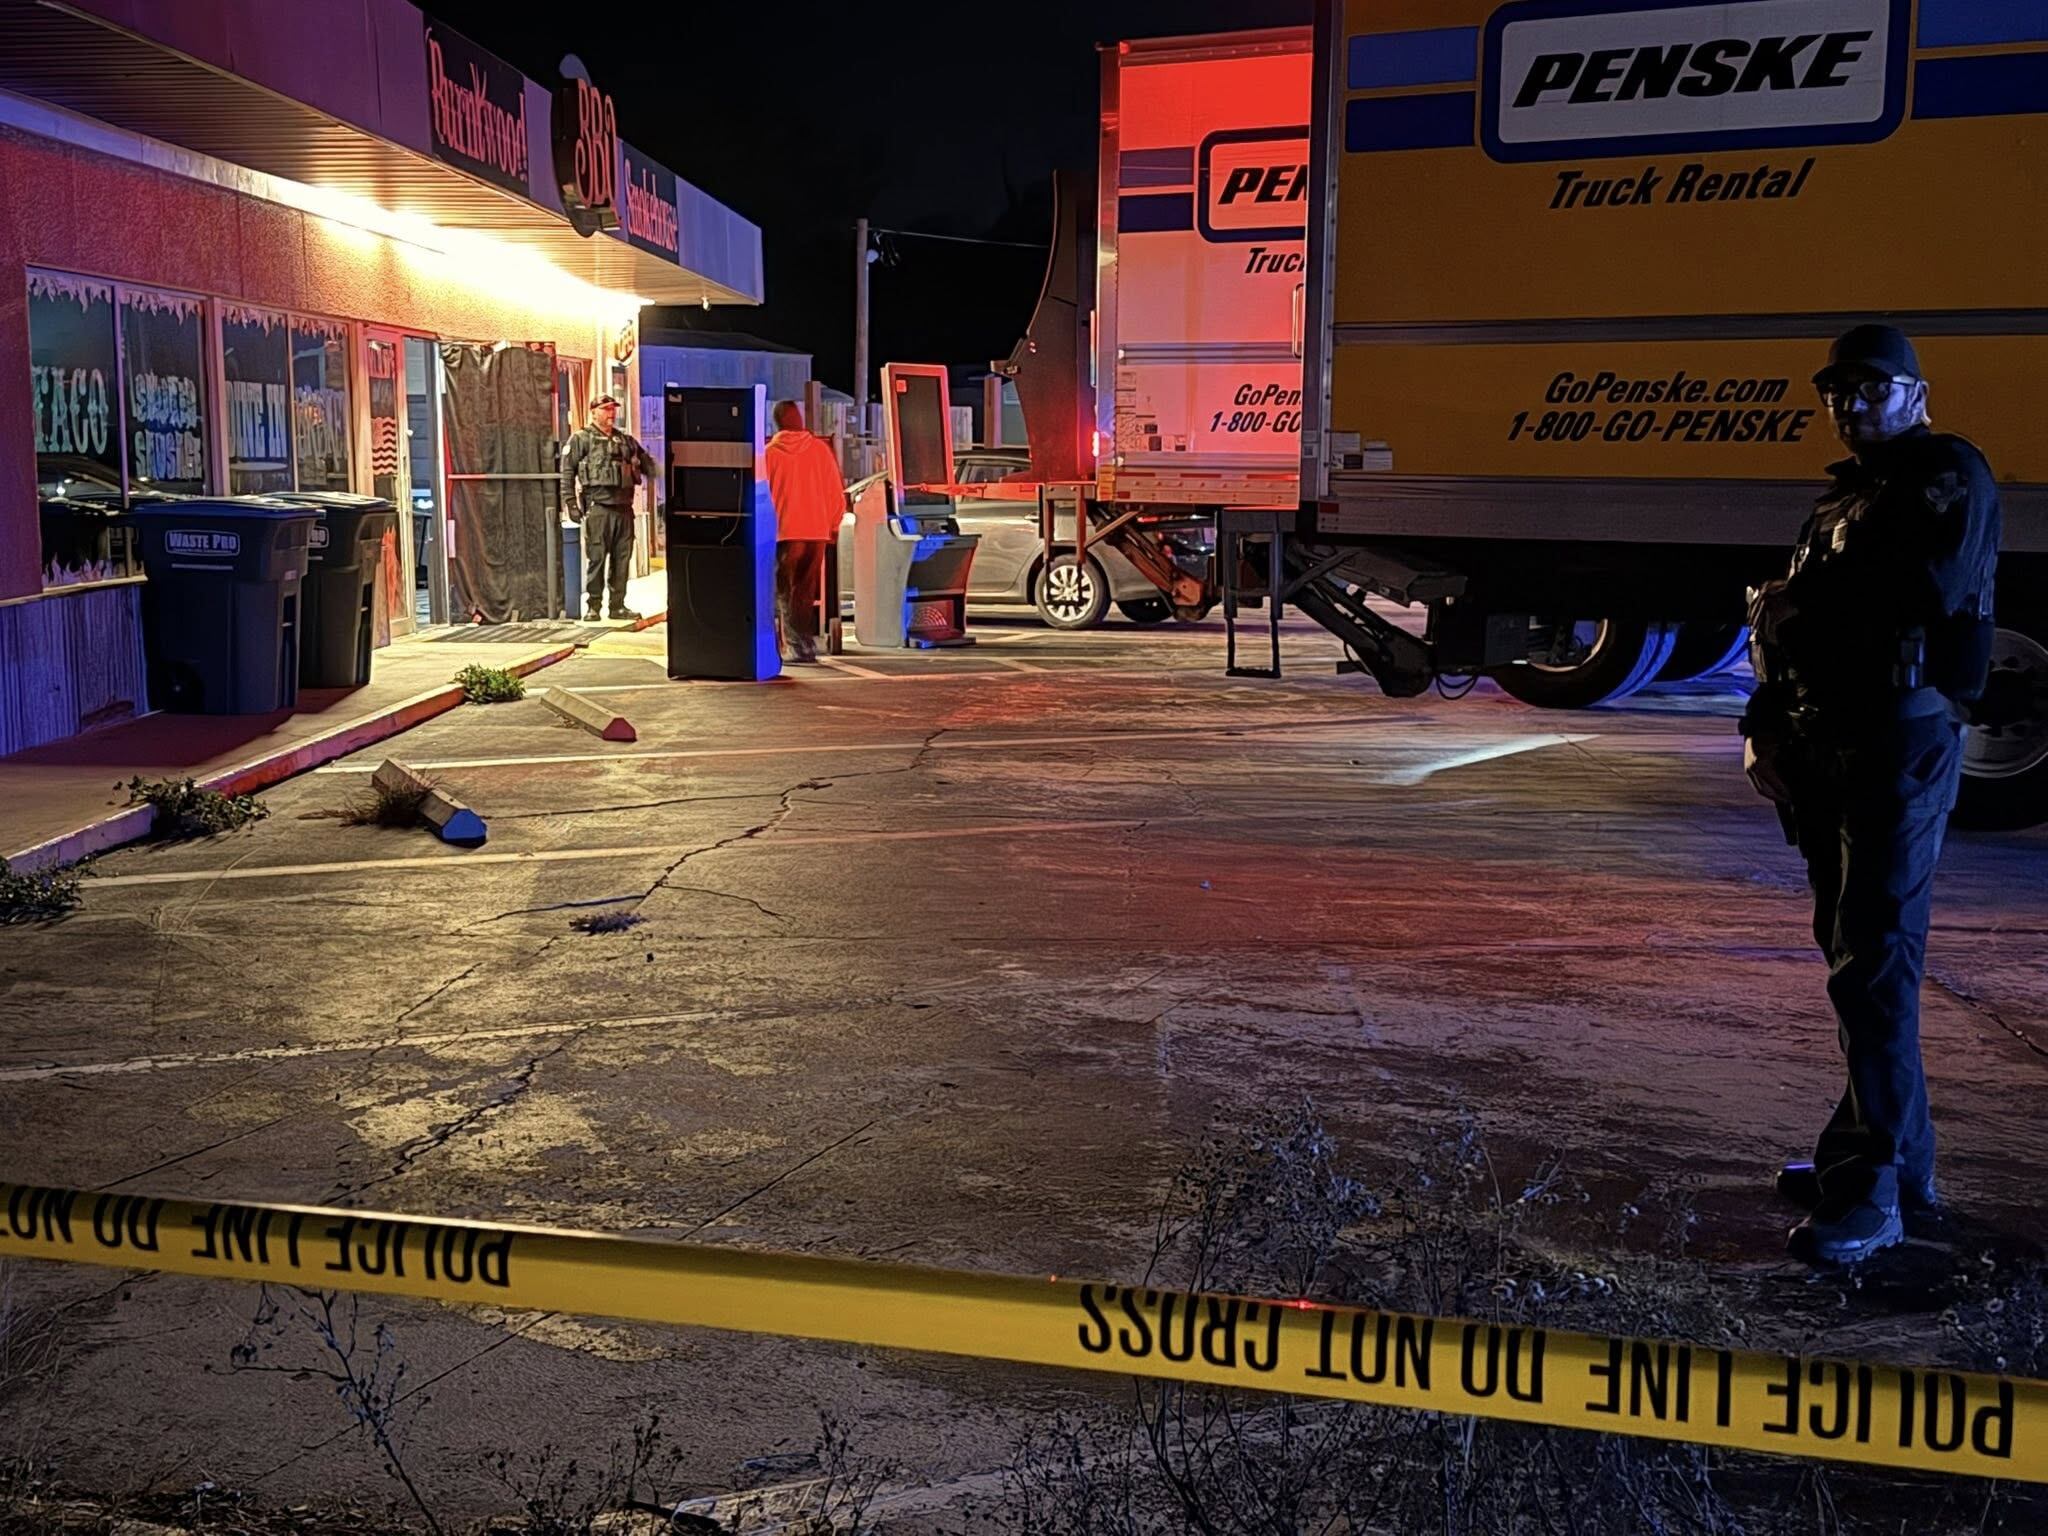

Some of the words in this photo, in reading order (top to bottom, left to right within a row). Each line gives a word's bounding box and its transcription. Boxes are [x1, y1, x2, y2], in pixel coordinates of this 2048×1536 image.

[1512, 31, 1873, 108] PENSKE
[575, 78, 622, 224] BBQ
[1549, 165, 1663, 210] Truck
[1666, 158, 1816, 204] Rental
[266, 383, 287, 458] IN
[1233, 383, 1302, 407] GoPen
[1543, 371, 1789, 405] GoPenske.com
[1508, 409, 1816, 443] 1-800-GO-PENSKE
[169, 533, 209, 549] WASTE
[212, 534, 237, 550] PRO
[0, 1183, 79, 1244] NO
[93, 1193, 166, 1252] DO
[191, 1204, 304, 1268] LINE
[325, 1214, 516, 1288] POLICE
[1078, 1284, 1284, 1372] CROSS
[1305, 1309, 1435, 1390] NOT
[1461, 1323, 1546, 1403] DO
[1585, 1337, 1732, 1427] LINE
[1762, 1356, 2014, 1459] POLICE
